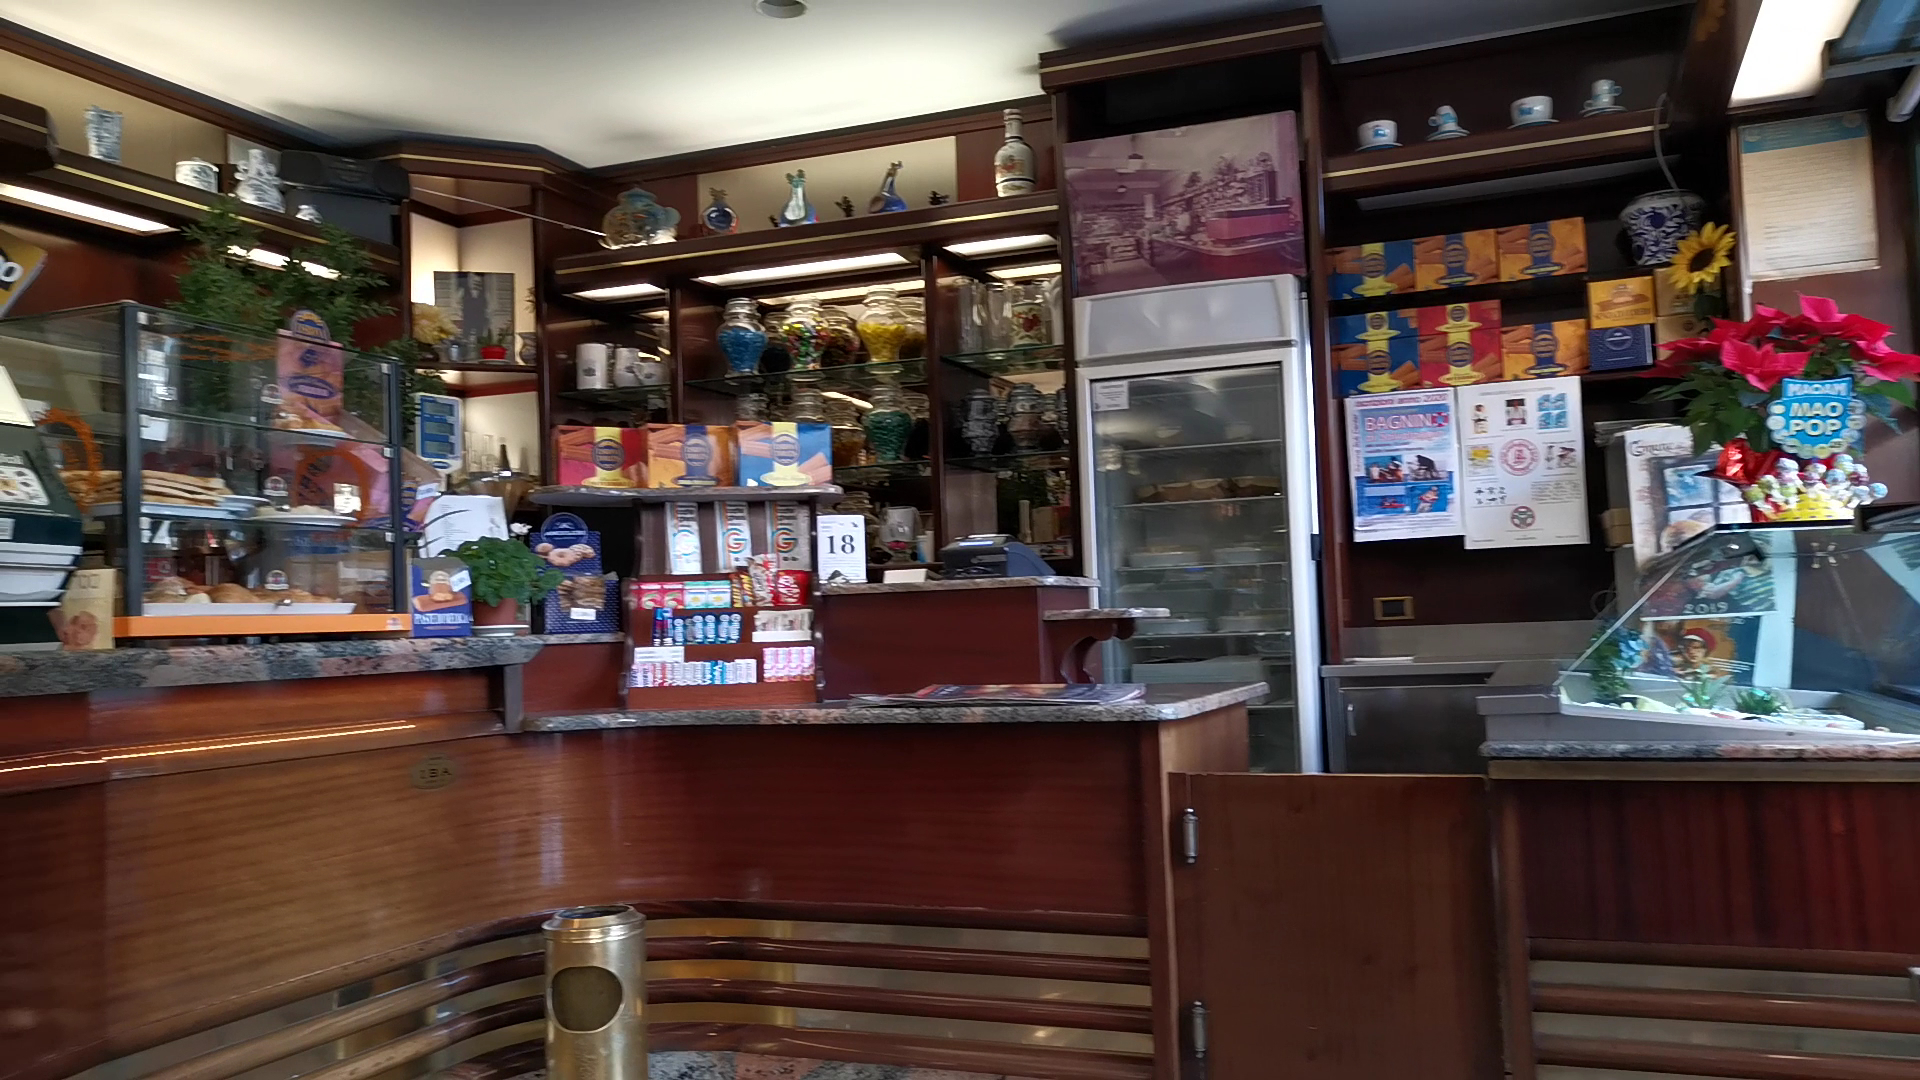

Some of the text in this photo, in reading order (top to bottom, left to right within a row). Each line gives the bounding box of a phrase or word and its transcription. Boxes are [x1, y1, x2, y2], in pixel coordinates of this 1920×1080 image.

[1789, 402, 1844, 418] MAO
[1788, 419, 1842, 436] POP
[827, 534, 856, 555] 18
[1683, 602, 1728, 614] 2019
